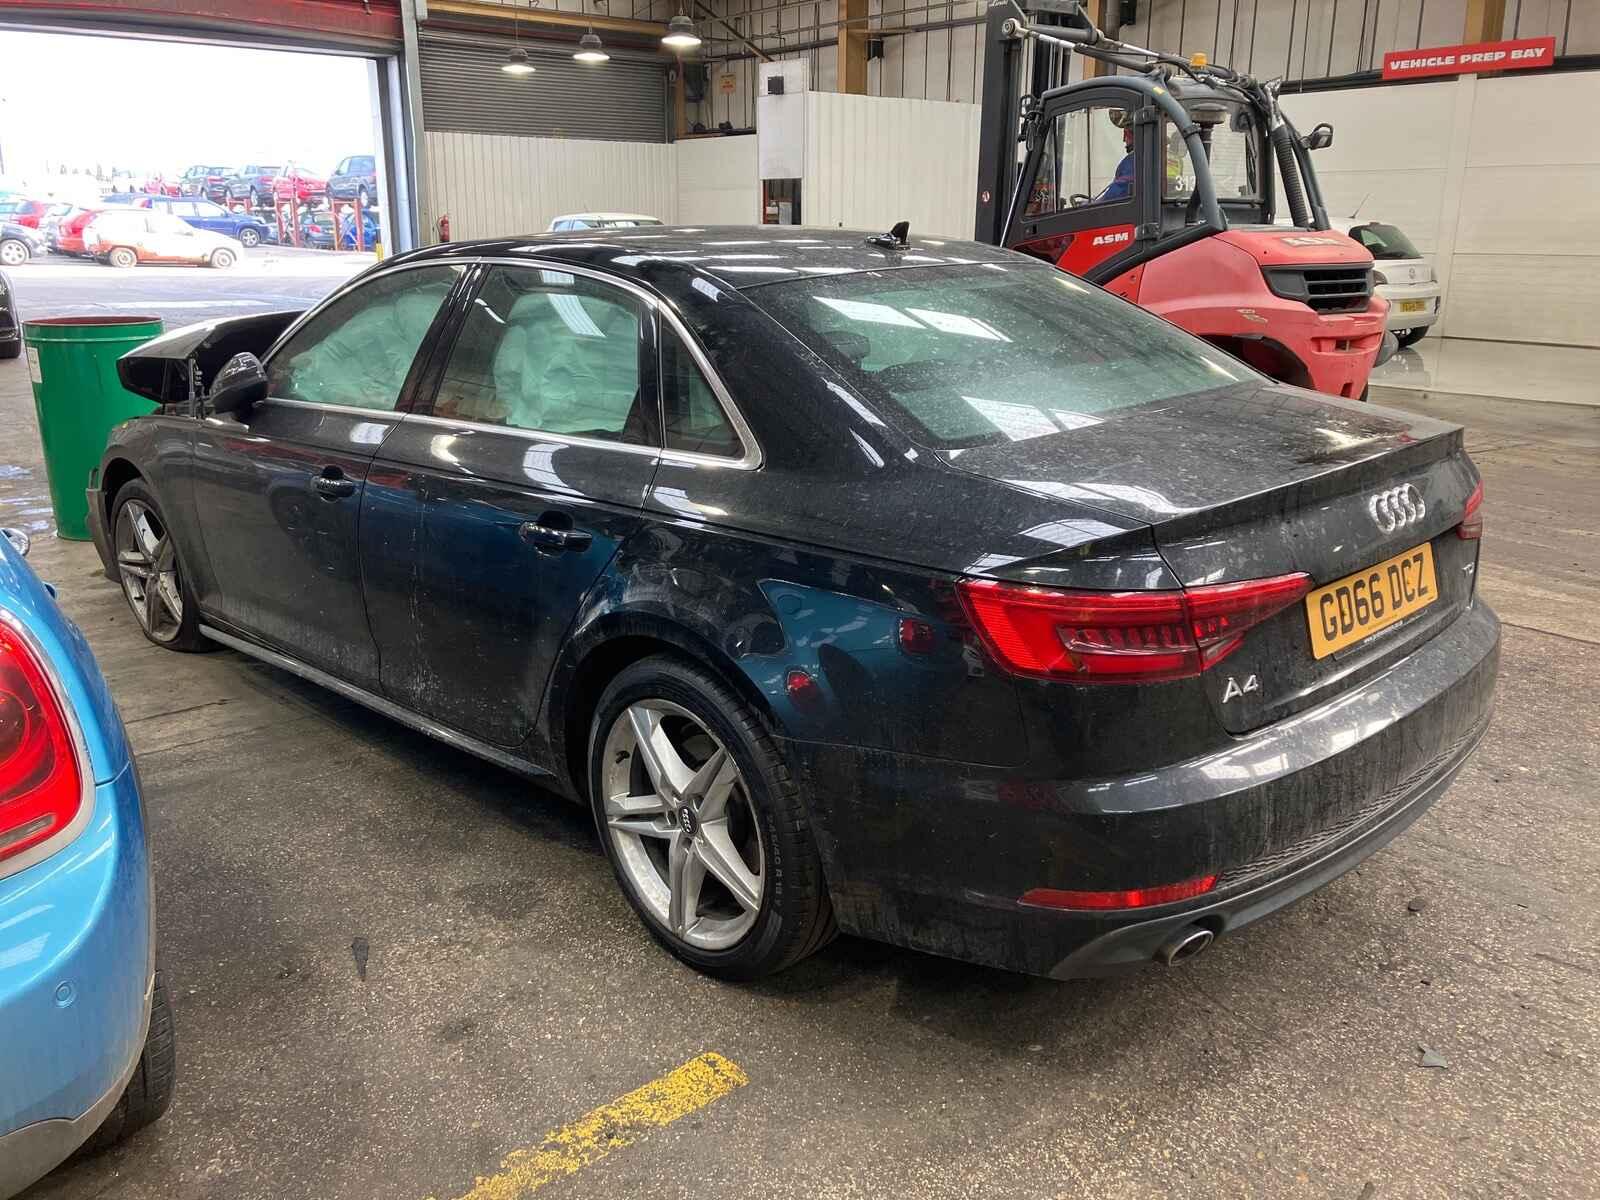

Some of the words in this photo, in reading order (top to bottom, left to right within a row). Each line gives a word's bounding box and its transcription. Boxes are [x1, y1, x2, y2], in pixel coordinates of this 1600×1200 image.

[1390, 55, 1456, 70] VEHICLE
[1460, 51, 1506, 64] PREP
[1511, 47, 1546, 60] BAY
[1092, 232, 1129, 246] ASM
[1319, 572, 1385, 641] GD66
[1387, 552, 1429, 610] DCZ
[1222, 674, 1259, 703] A4
